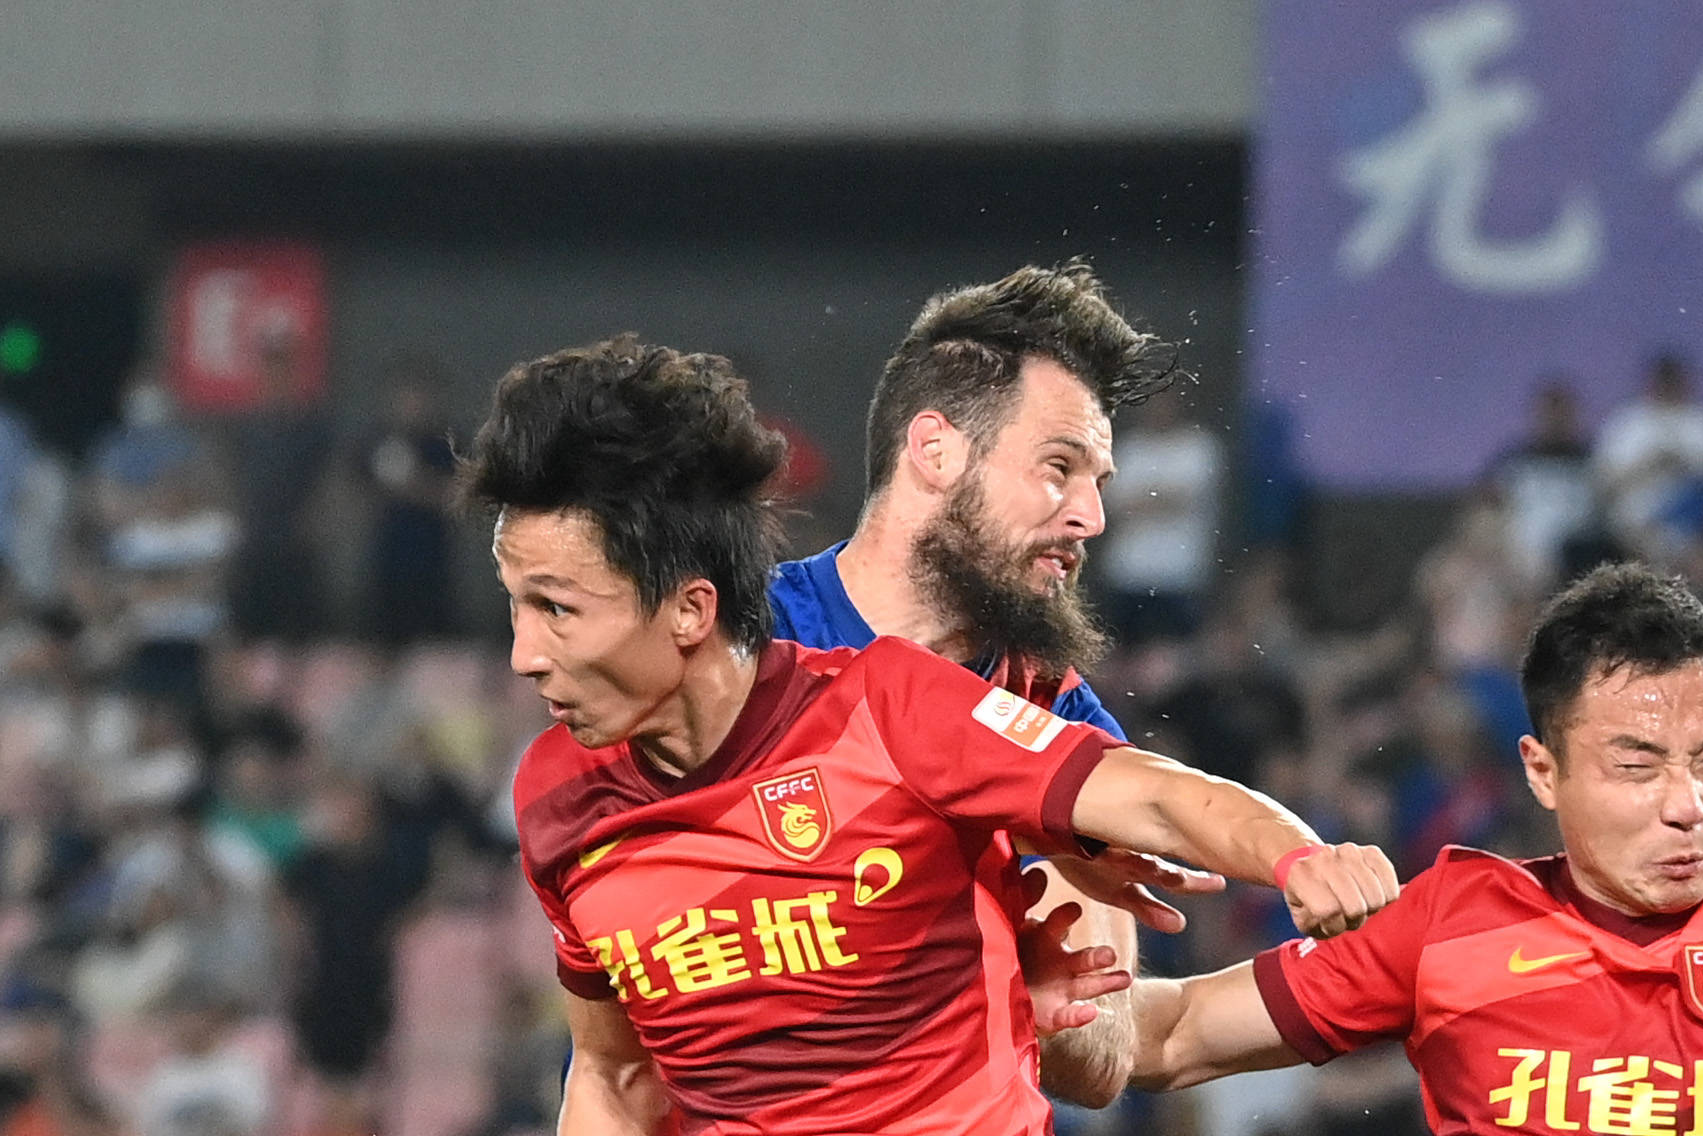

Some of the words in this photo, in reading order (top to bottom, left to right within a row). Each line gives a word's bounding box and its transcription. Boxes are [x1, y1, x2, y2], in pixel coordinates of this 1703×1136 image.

[764, 776, 814, 801] CFFC
[586, 890, 859, 1000] 孔雀城
